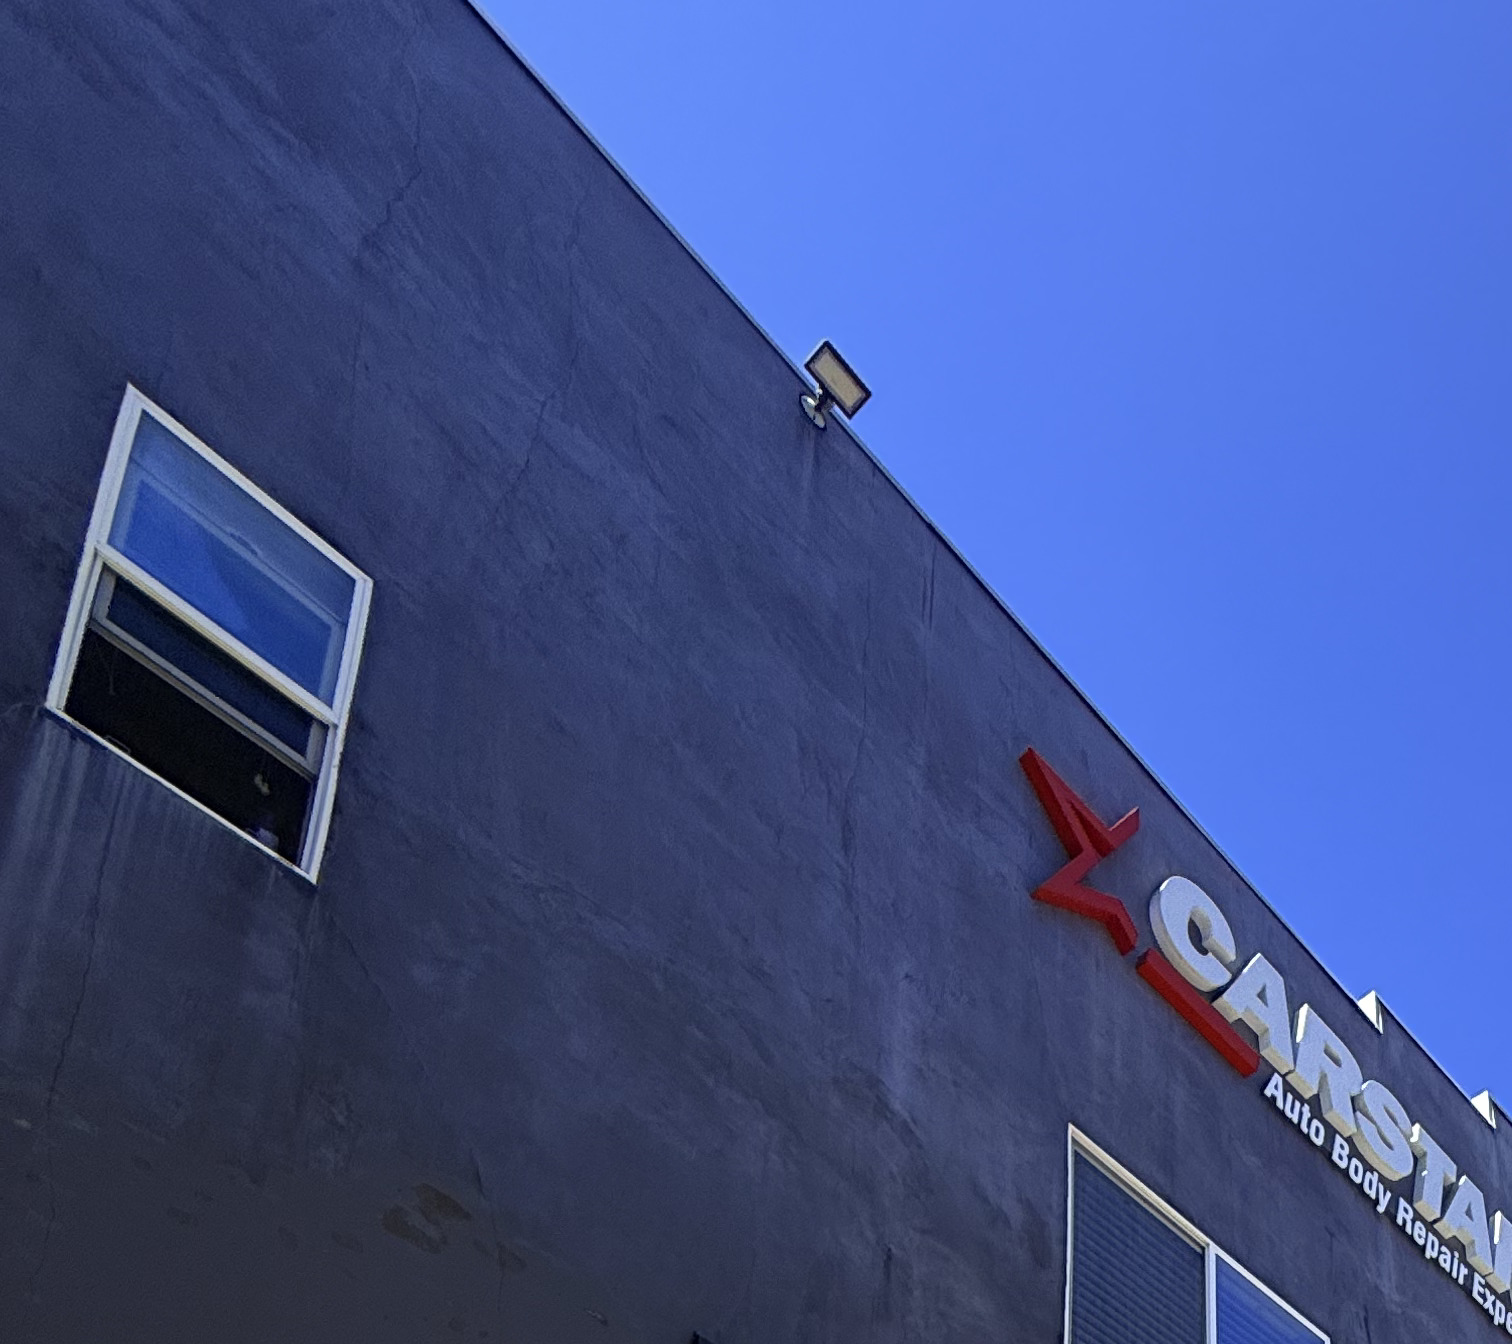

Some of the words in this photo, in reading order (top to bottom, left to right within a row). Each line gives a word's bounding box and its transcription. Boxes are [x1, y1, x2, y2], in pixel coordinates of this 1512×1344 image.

[1263, 1072, 1325, 1147] Auto
[1331, 1134, 1392, 1214] Body
[1396, 1196, 1468, 1285] Repair
